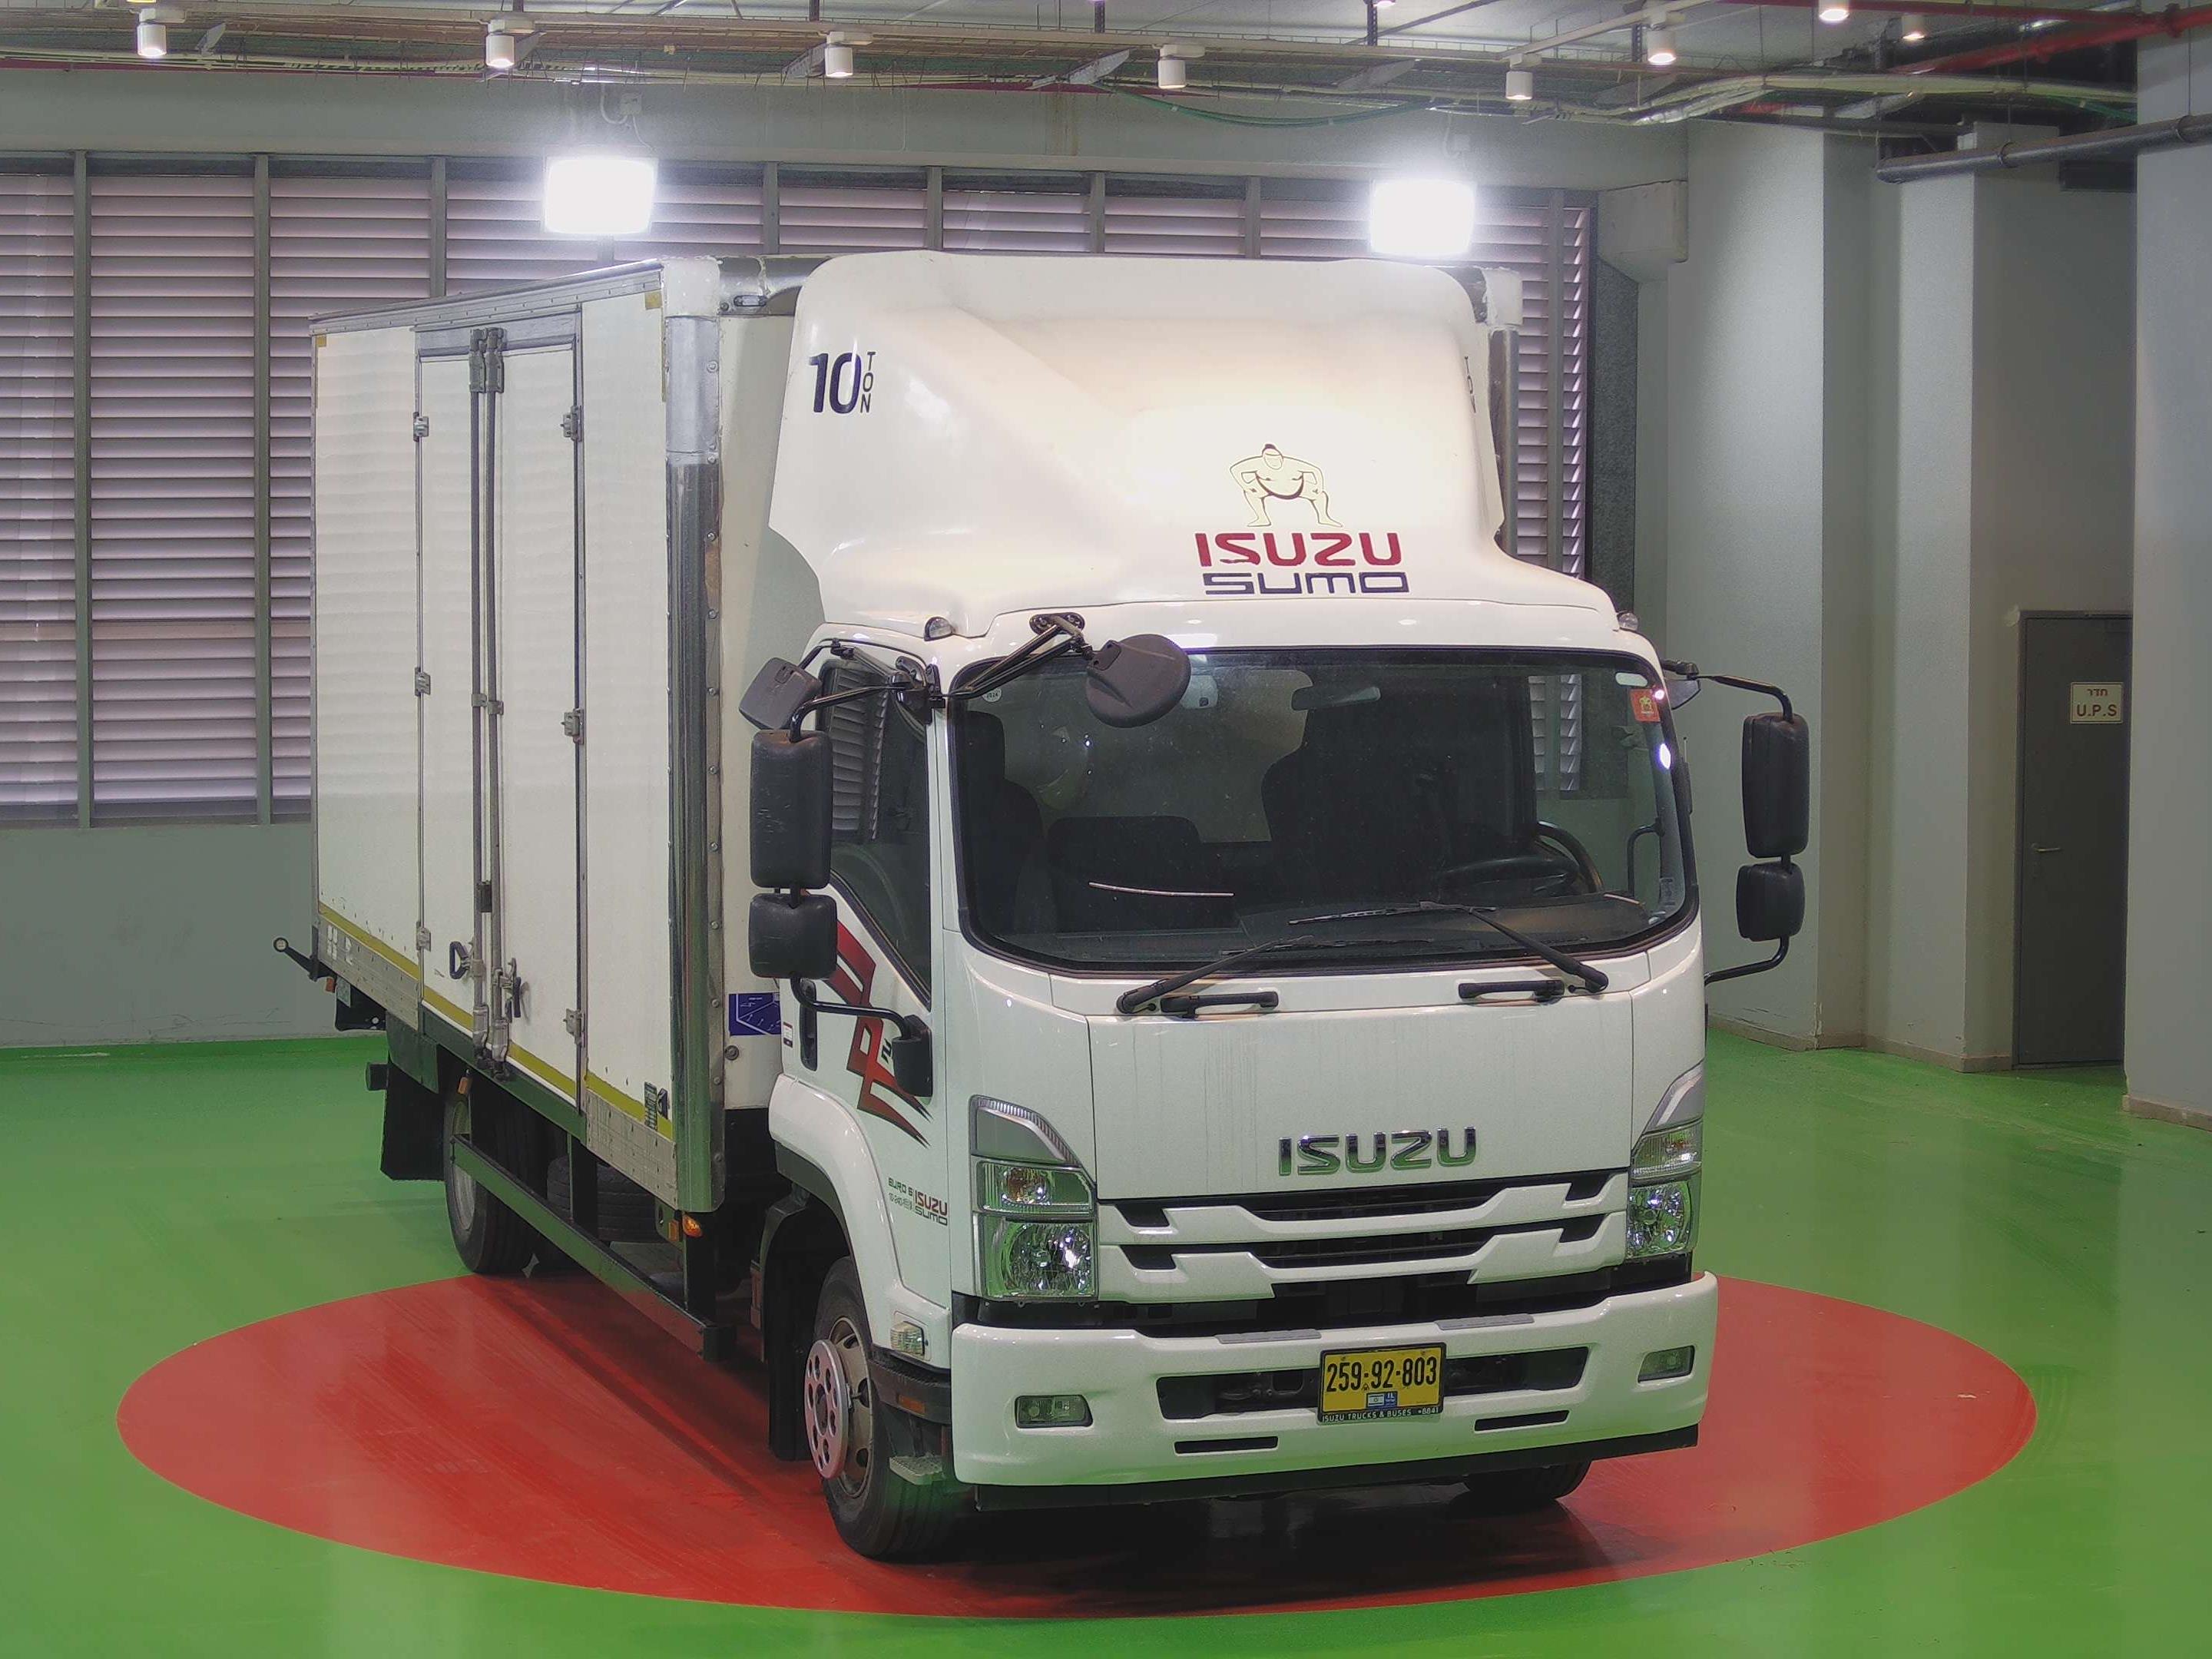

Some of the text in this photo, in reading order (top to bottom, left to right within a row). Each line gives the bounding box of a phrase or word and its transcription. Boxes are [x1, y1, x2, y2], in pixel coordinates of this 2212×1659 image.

[809, 352, 862, 414] 10
[860, 351, 876, 413] TON
[1194, 532, 1402, 567] ISUZU
[1202, 571, 1409, 595] SUMO
[2086, 688, 2108, 697] חדר
[2076, 704, 2118, 717] U.P.S
[1279, 1126, 1476, 1176] ISUZU
[888, 1177, 907, 1194] EURO
[915, 1190, 948, 1216] ISUZU
[915, 1205, 948, 1226] SUMO
[1348, 1411, 1376, 1420] TRUCKS
